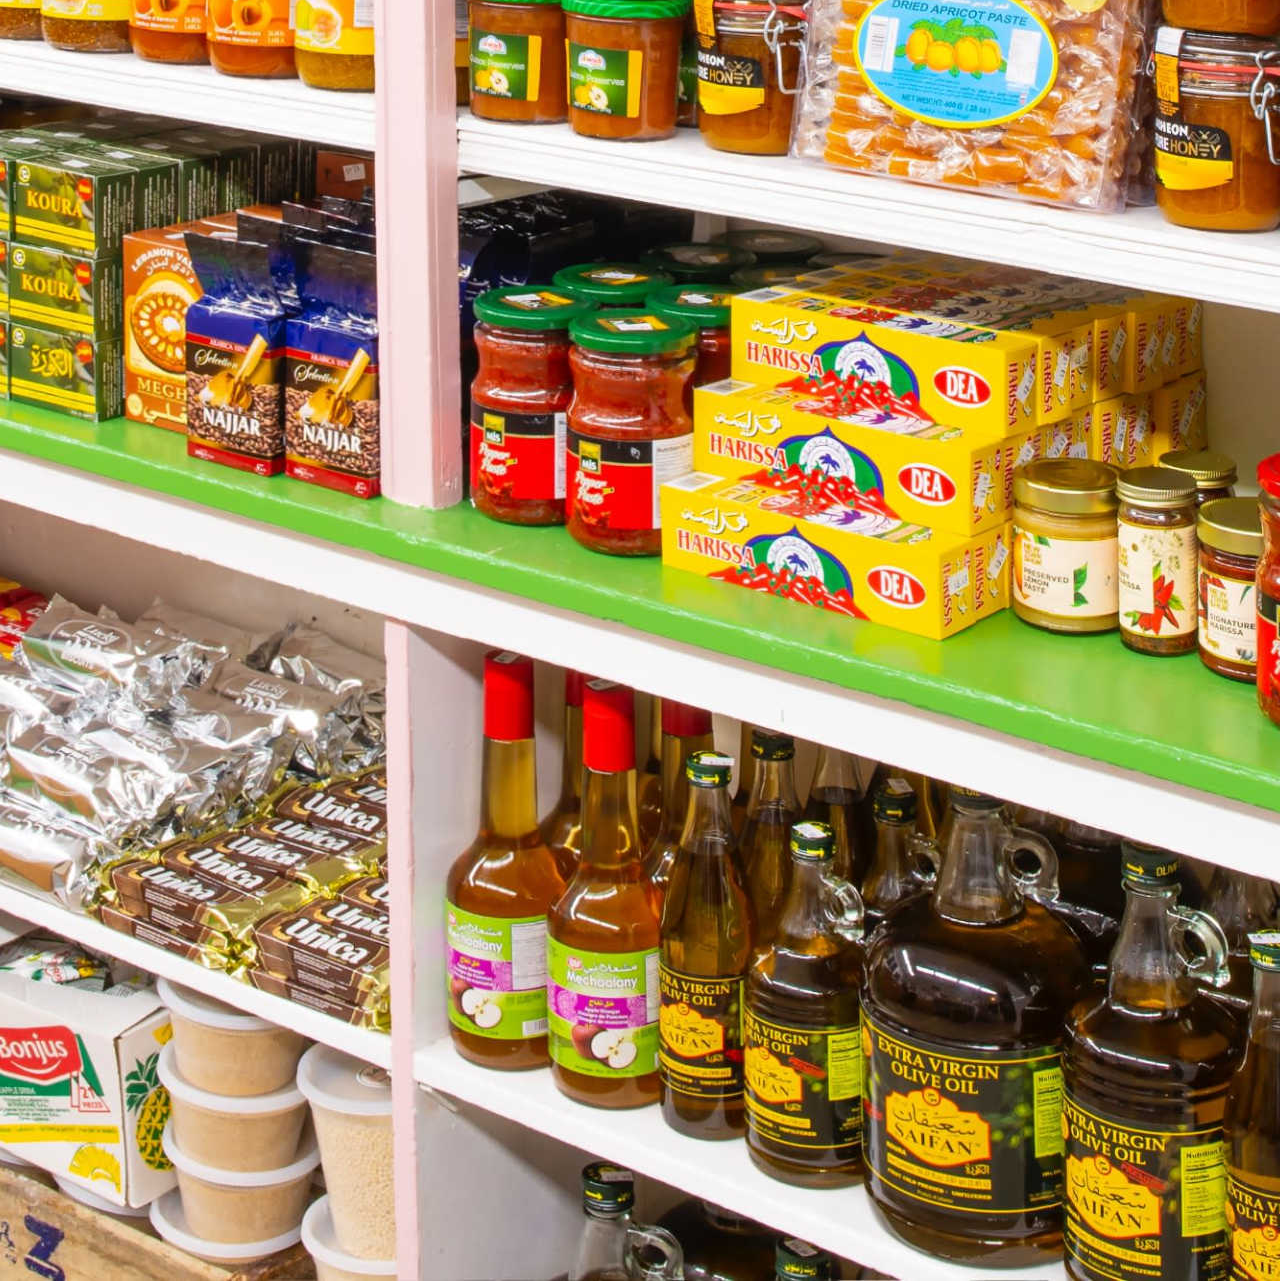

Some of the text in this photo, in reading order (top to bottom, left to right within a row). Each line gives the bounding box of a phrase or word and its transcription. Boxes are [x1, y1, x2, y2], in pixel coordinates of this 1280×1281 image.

[892, 0, 1028, 26] DRIED APRICOT PASTE
[1170, 140, 1222, 159] HONEY
[26, 190, 84, 218] KOURA
[131, 248, 175, 271] LEBANON
[21, 274, 81, 302] KOURA
[194, 348, 239, 370] Selection
[746, 341, 824, 376] HARISSA
[1099, 330, 1110, 391] HARISSA
[294, 365, 340, 386] Selection
[946, 373, 979, 401] DEA
[1043, 350, 1052, 414] HARISSA
[1007, 362, 1018, 427] HARISSA
[202, 407, 261, 437] NAJJAR
[302, 424, 362, 454] NAJJAR
[709, 433, 788, 469] HARISSA
[909, 471, 943, 499] DEA
[1005, 447, 1013, 510] HARISSA
[677, 530, 757, 568] HARISSA
[879, 573, 914, 602] DEA
[974, 546, 984, 611] HARISSA
[1023, 567, 1069, 583] PRESERVED
[1023, 576, 1050, 588] LEMON
[1023, 583, 1046, 594] PASTE
[1209, 613, 1256, 630] SIGNATURE
[1210, 622, 1244, 637] HARISSA
[303, 792, 381, 832] Unica
[272, 820, 350, 851] Unica
[227, 835, 302, 866] Unica
[190, 848, 264, 890] Unica
[141, 866, 216, 901] Unica
[285, 918, 369, 964] Unica
[567, 970, 638, 989] Mechaalany
[682, 982, 730, 995] VIRGIN
[692, 995, 716, 1006] OIL
[761, 1027, 809, 1046] VIRGIN
[771, 1041, 794, 1055] OIL
[878, 1036, 1000, 1079] EXTRA VIRGIN
[890, 1060, 979, 1095] OLIVE OIL
[80, 1087, 95, 1100] 21
[894, 1123, 973, 1156] SAIFAN
[1070, 1126, 1146, 1166] OLIVE OIL
[1101, 1127, 1168, 1152] VIRGIN
[1072, 1188, 1142, 1231] SAIFAN
[1236, 1201, 1277, 1227] OLIVE
